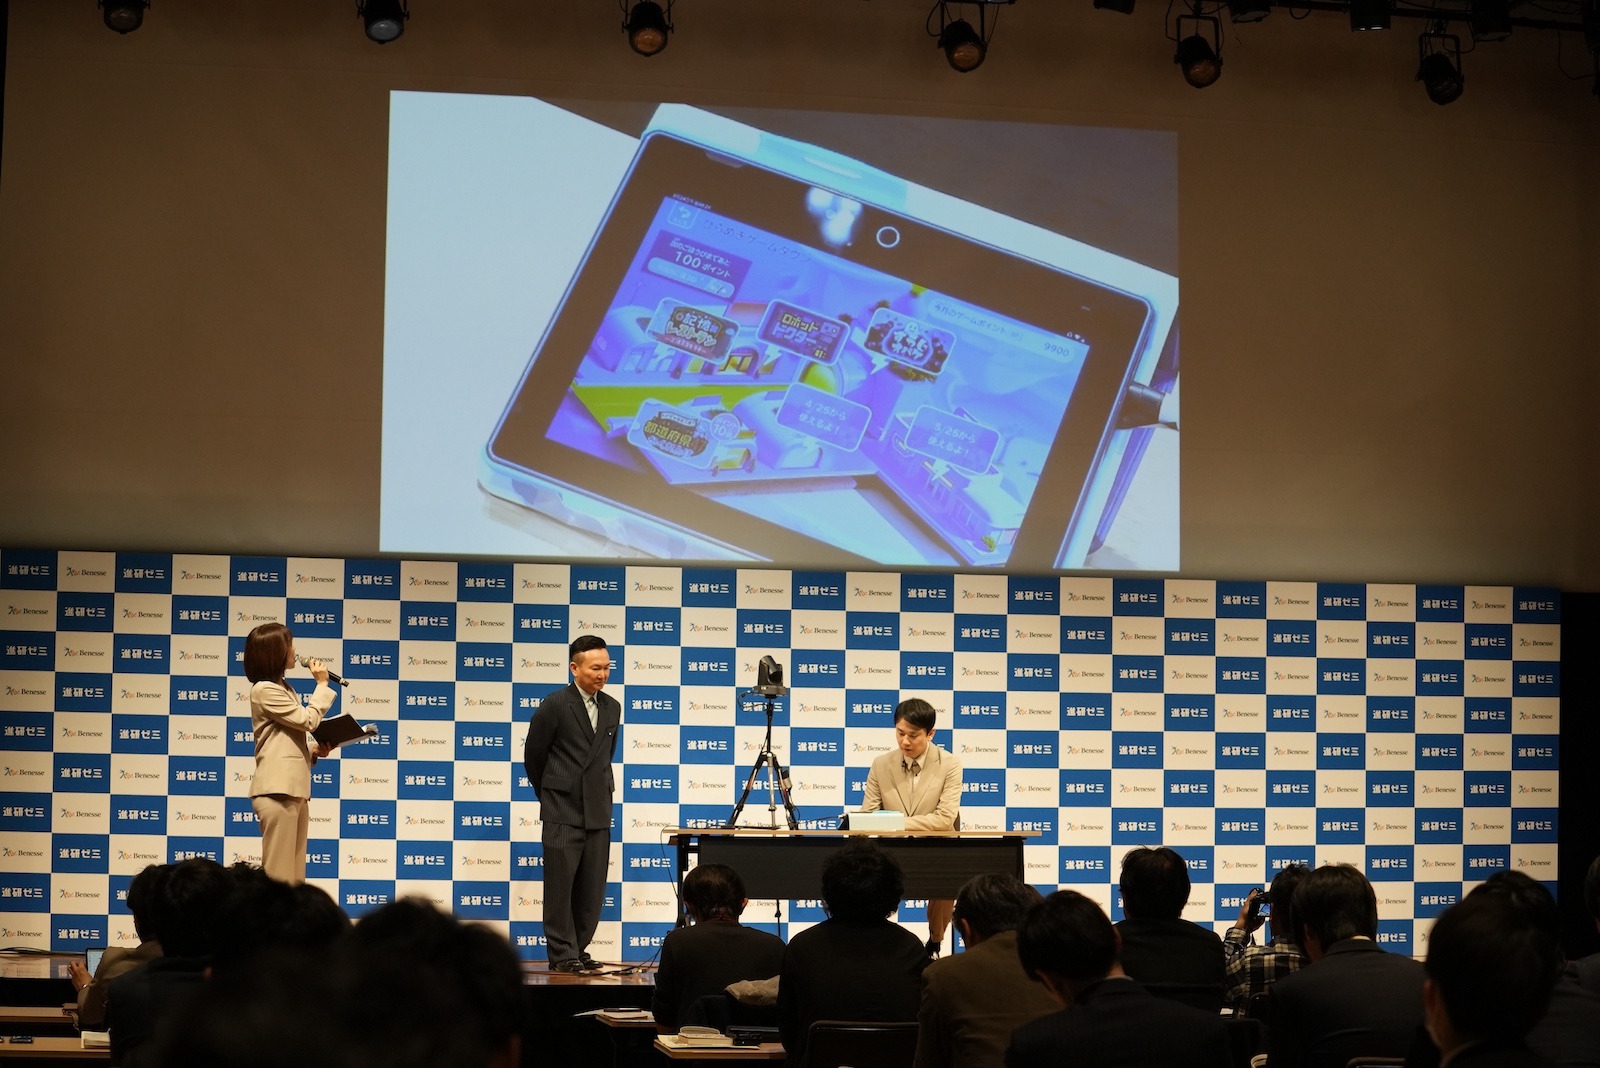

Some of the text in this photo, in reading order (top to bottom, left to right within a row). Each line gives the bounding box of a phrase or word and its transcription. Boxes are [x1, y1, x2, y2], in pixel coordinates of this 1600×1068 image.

[674, 250, 731, 278] 100 ポイント
[782, 313, 819, 333] ロボット
[665, 321, 717, 347] レストラン
[772, 322, 818, 345] ドクター
[1044, 342, 1069, 357] 9900
[644, 421, 692, 448] 都道府県
[8, 565, 50, 575] 進研ゼミ
[123, 568, 164, 579] 進研ゼミ
[237, 571, 279, 582] 進研ゼミ
[351, 574, 393, 585] 進研ゼミ
[464, 577, 506, 588] 進研ゼミ
[577, 580, 618, 590] 進研ゼミ
[688, 583, 729, 593] 進研ゼミ
[799, 586, 838, 596] 進研ゼミ
[907, 588, 947, 598] 進研ゼミ
[1014, 591, 1053, 600] 進研ゼミ
[1119, 593, 1157, 602] 進研ゼミ
[1222, 595, 1259, 604] 進研ゼミ
[1323, 597, 1359, 606] 進研ゼミ
[1422, 599, 1457, 608] 進研ゼミ
[1519, 601, 1553, 610] 進研ゼミ
[293, 613, 335, 623] 進研ゼミ
[632, 621, 673, 631] 進研ゼミ
[961, 628, 999, 637] 進研ゼミ
[1273, 633, 1309, 643] 進研ゼミ
[6, 645, 48, 656] 進研ゼミ
[121, 648, 162, 659] 進研ゼミ
[349, 654, 391, 664] 進研ゼミ
[463, 657, 504, 667] 進研ゼミ
[798, 663, 837, 673] 進研ゼミ
[906, 665, 946, 675] 進研ゼミ
[1014, 667, 1052, 677] 進研ゼミ
[1119, 669, 1157, 678] 進研ゼミ
[1222, 670, 1259, 679] 進研ゼミ
[1323, 671, 1359, 681] 進研ゼミ
[1422, 673, 1457, 682] 進研ゼミ
[1519, 675, 1553, 683] 進研ゼミ
[62, 687, 104, 697] 進研ゼミ
[631, 700, 672, 709] 進研ゼミ
[852, 703, 891, 713] 進研ゼミ
[1066, 706, 1104, 716] 進研ゼミ
[1373, 709, 1408, 718] 進研ゼミ
[4, 726, 46, 736] 進研ゼミ
[119, 729, 161, 739] 進研ゼミ
[797, 741, 837, 751] 進研ゼミ
[1222, 746, 1259, 755] 進研ゼミ
[1518, 748, 1552, 757] 進研ゼミ
[61, 768, 103, 778] 進研ゼミ
[176, 770, 218, 780] 進研ゼミ
[405, 775, 446, 785] 進研ゼミ
[630, 778, 671, 788] 進研ゼミ
[1066, 783, 1104, 792] 進研ゼミ
[1170, 783, 1207, 792] 進研ゼミ
[1272, 784, 1309, 793] 進研ゼミ
[1373, 784, 1408, 793] 進研ゼミ
[1470, 784, 1505, 793] 進研ゼミ
[347, 814, 389, 824] 進研ゼミ
[796, 820, 836, 829] 進研ゼミ
[1012, 821, 1051, 830] 進研ゼミ
[1118, 821, 1156, 830] 進研ゼミ
[1221, 821, 1258, 830] 進研ゼミ
[1322, 821, 1358, 830] 進研ゼミ
[1421, 821, 1457, 830] 進研ゼミ
[1518, 821, 1551, 830] 進研ゼミ
[403, 854, 445, 864] 進研ゼミ
[629, 857, 670, 867] 進研ゼミ
[1372, 858, 1408, 867] 進研ゼミ
[1470, 858, 1505, 867] 進研ゼミ
[1065, 860, 1103, 869] 進研ゼミ
[346, 893, 387, 903] 進研ゼミ
[460, 895, 501, 905] 進研ゼミ
[58, 929, 100, 939] 進研ゼミ
